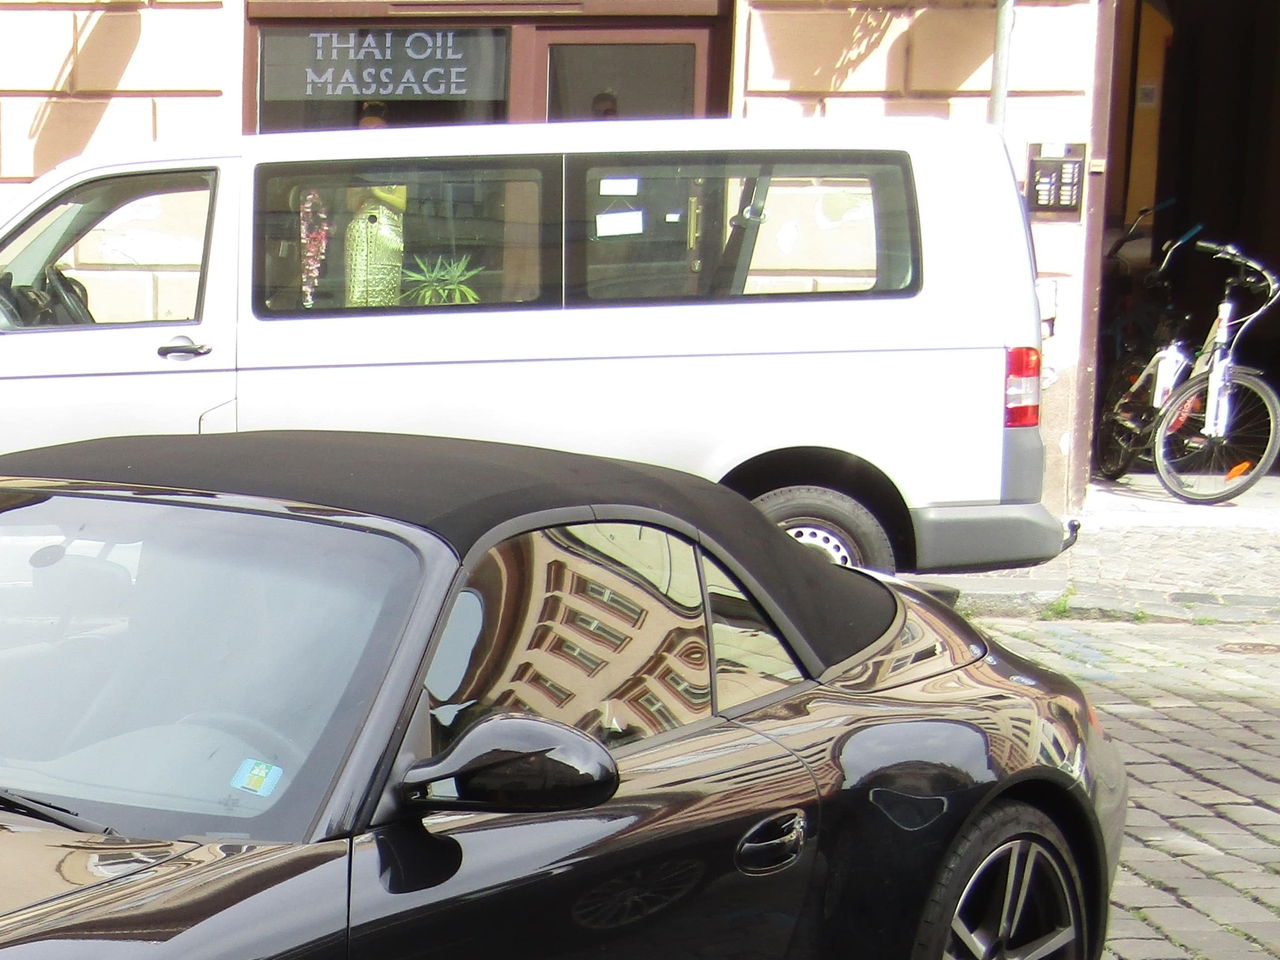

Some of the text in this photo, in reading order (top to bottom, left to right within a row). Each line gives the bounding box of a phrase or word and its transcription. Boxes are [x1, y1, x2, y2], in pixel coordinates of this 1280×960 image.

[308, 32, 464, 60] THAI OIL
[305, 67, 468, 95] MASSAGE
